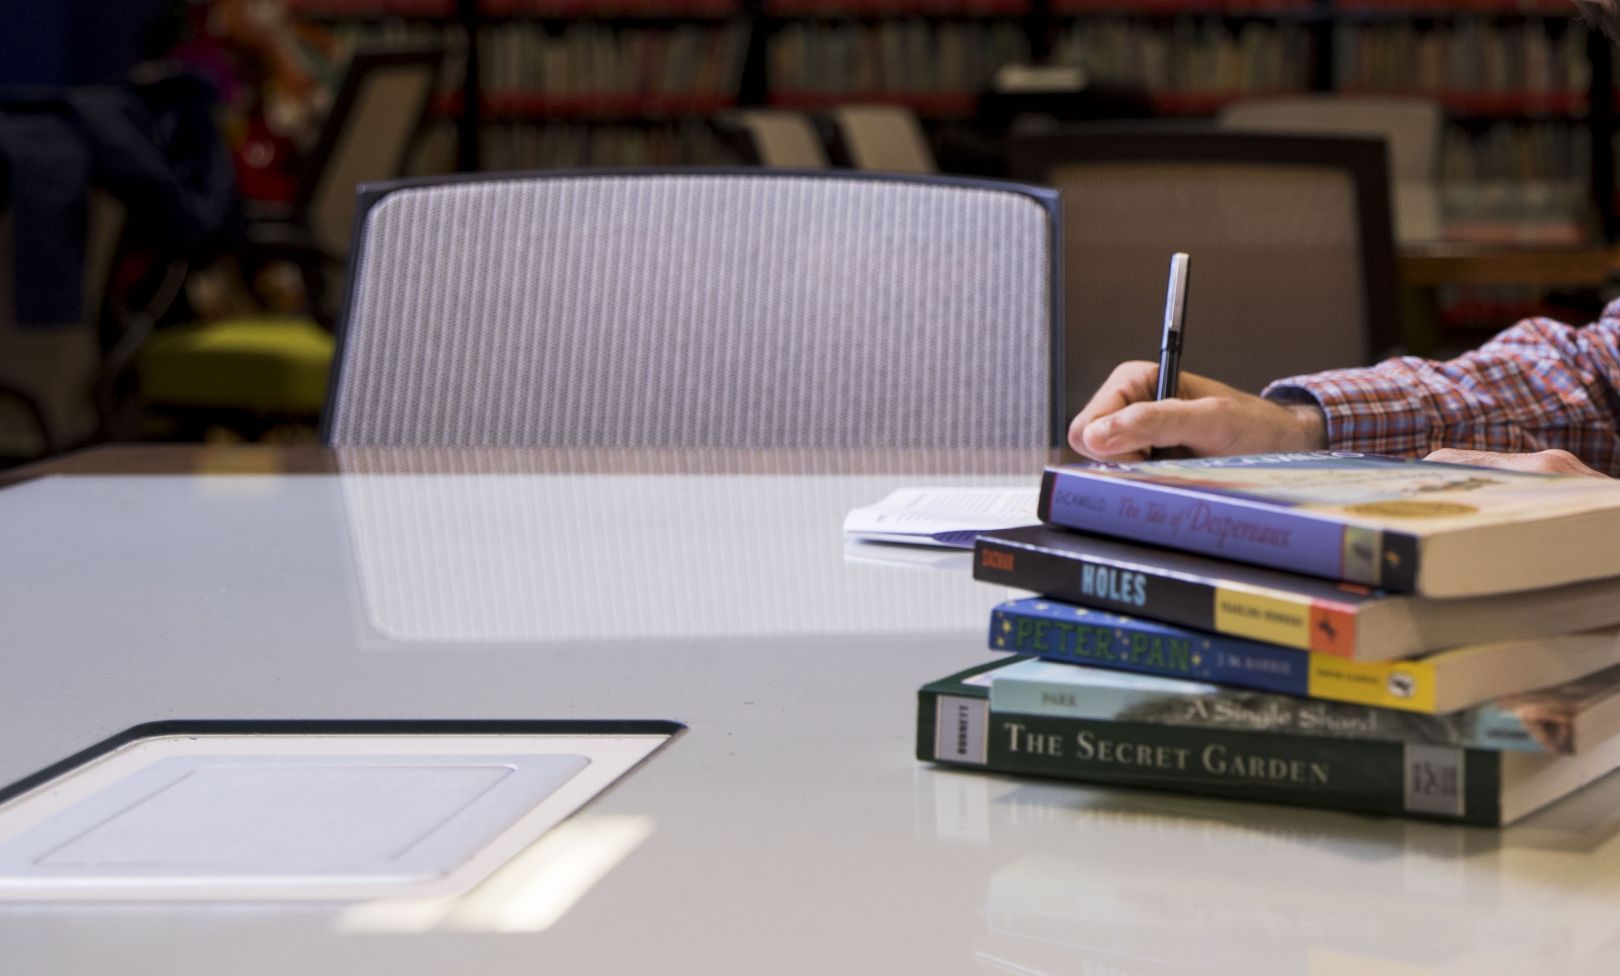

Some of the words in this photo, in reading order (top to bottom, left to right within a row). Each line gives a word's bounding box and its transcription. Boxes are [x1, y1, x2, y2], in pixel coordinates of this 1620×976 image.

[1081, 562, 1147, 607] HOLES
[1015, 617, 1116, 661] PETER
[1122, 631, 1191, 671] PAN
[956, 704, 969, 755] BURNETT
[1183, 697, 1209, 722] A
[1213, 699, 1294, 730] Single
[1297, 704, 1379, 732] Shard
[1003, 723, 1063, 757] THE
[1076, 730, 1190, 771] SECRET
[1202, 744, 1331, 785] GARDEN
